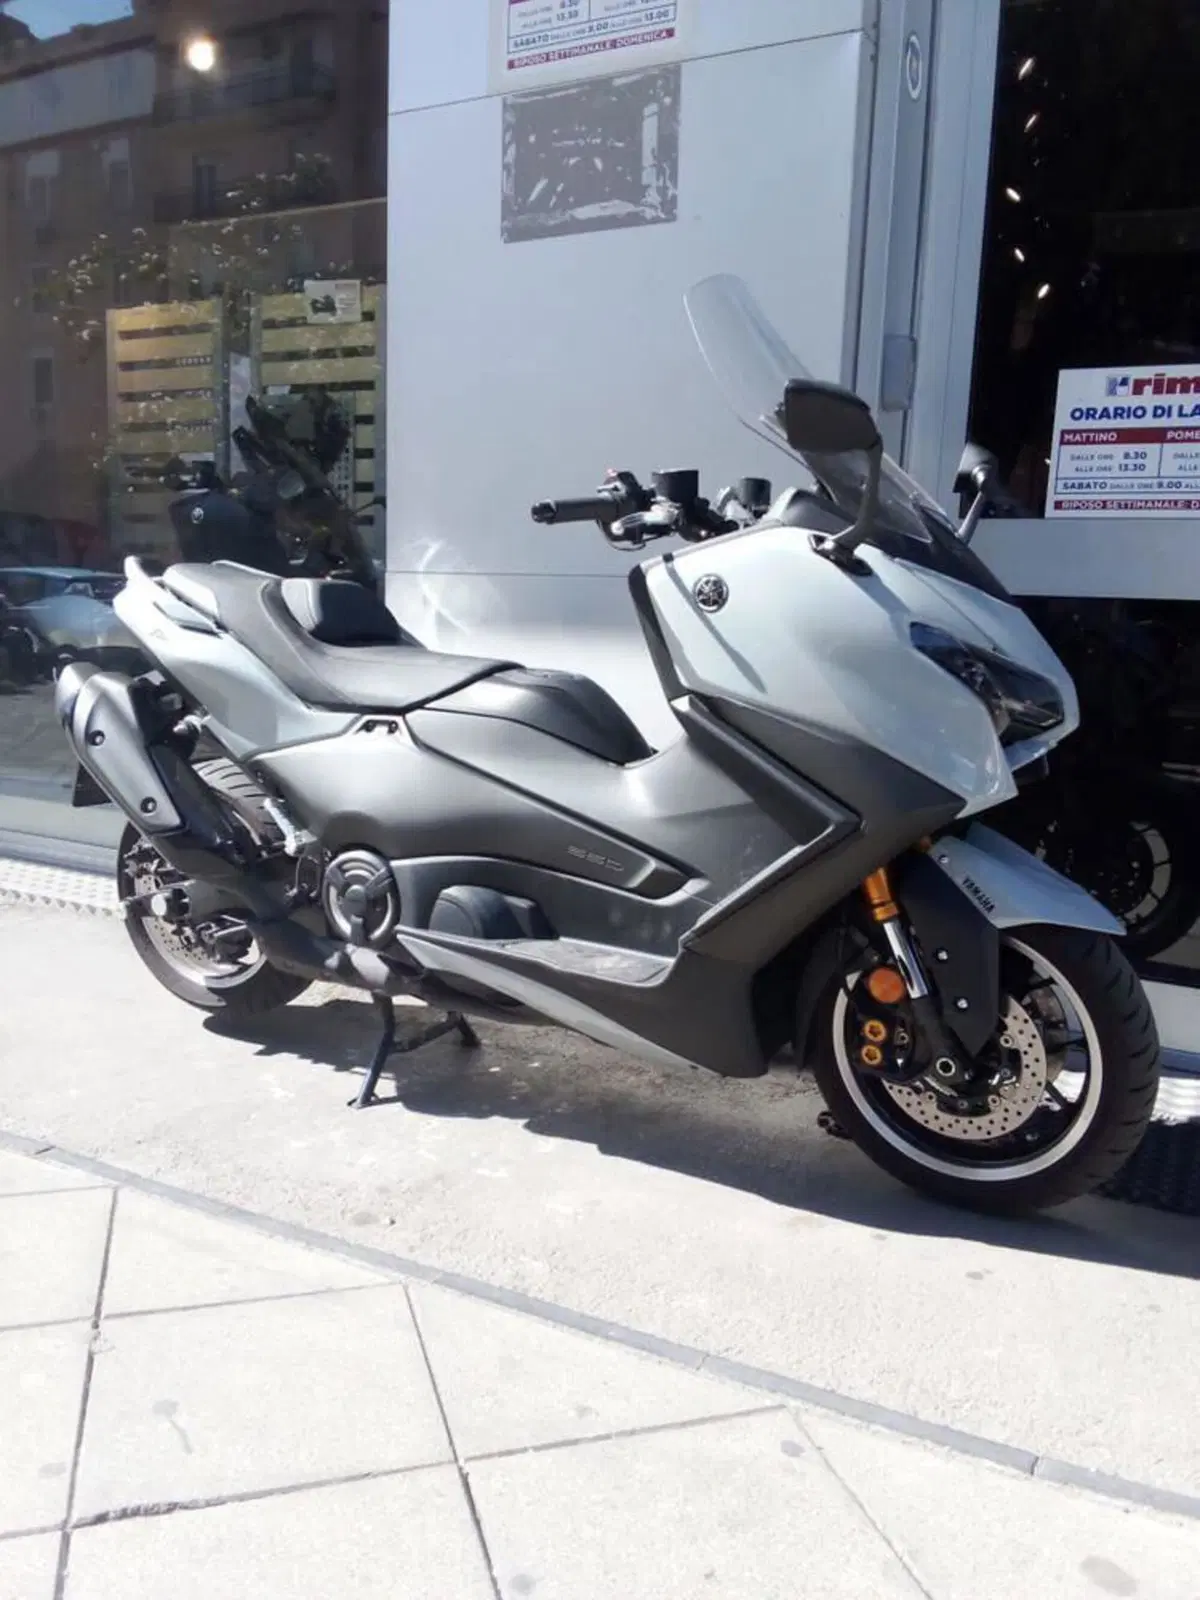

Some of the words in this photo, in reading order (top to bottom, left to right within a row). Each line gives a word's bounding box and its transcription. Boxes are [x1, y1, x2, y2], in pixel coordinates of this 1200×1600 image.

[514, 33, 550, 48] SABATO
[513, 54, 547, 68] RIPOSO
[615, 28, 666, 48] DOMENICA
[1070, 405, 1147, 421] ORARIO
[1152, 404, 1172, 419] DI
[1178, 403, 1200, 419] LA
[1063, 431, 1118, 442] MATTINO
[1166, 431, 1200, 440] POME
[1123, 451, 1148, 460] 8.30
[1062, 481, 1108, 490] SABATO
[1062, 500, 1103, 510] RIPOSO
[962, 876, 995, 913] YAMAHA
